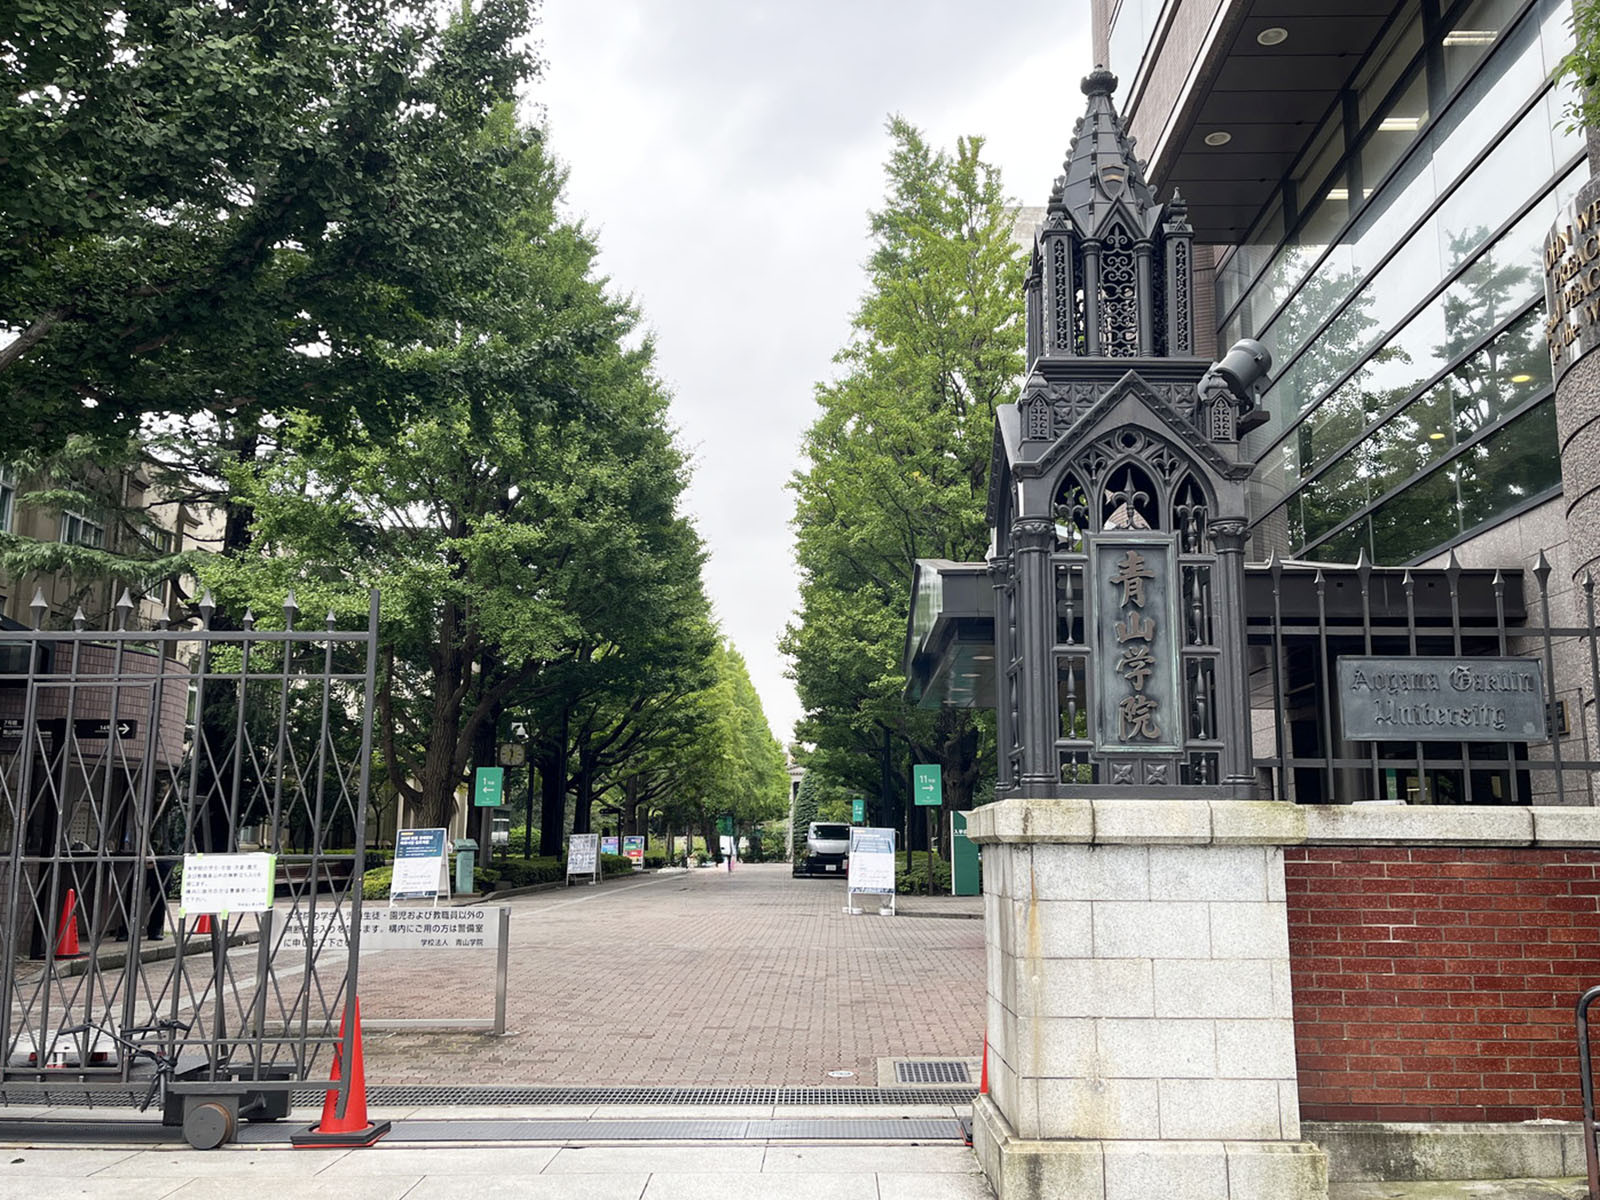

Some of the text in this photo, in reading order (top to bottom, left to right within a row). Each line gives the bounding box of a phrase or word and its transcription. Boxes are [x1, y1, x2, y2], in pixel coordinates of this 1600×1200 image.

[1554, 232, 1600, 291] PREAC
[1110, 550, 1161, 742] 青山学院
[1350, 665, 1535, 695] Aoyama Gakuin
[1374, 698, 1507, 731] University
